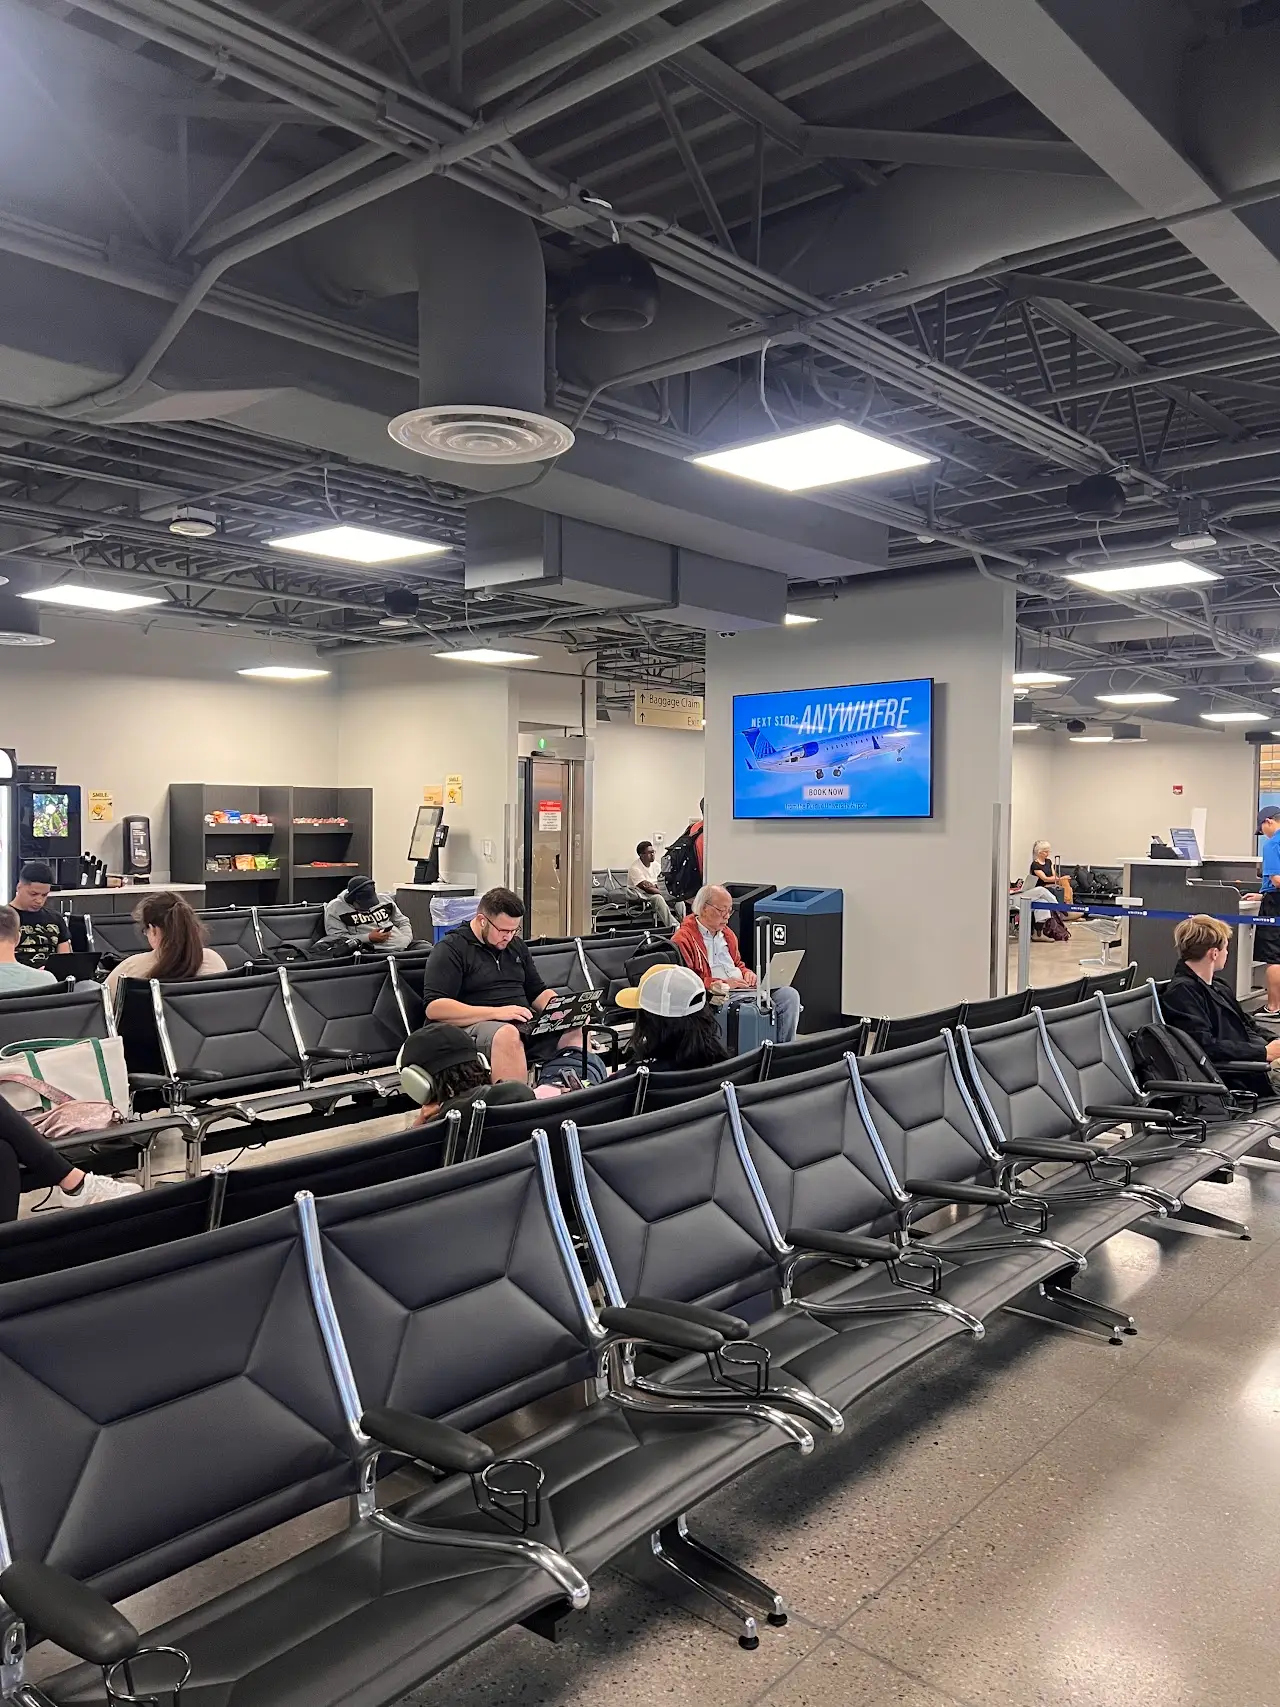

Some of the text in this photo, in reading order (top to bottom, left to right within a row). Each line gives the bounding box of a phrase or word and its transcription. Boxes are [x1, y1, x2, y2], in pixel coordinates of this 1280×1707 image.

[649, 694, 701, 709] Baggage Claim
[687, 716, 700, 727] Exit
[751, 696, 912, 735] NEXT STOP: ANYWHERE
[808, 788, 844, 796] BOOK NOW
